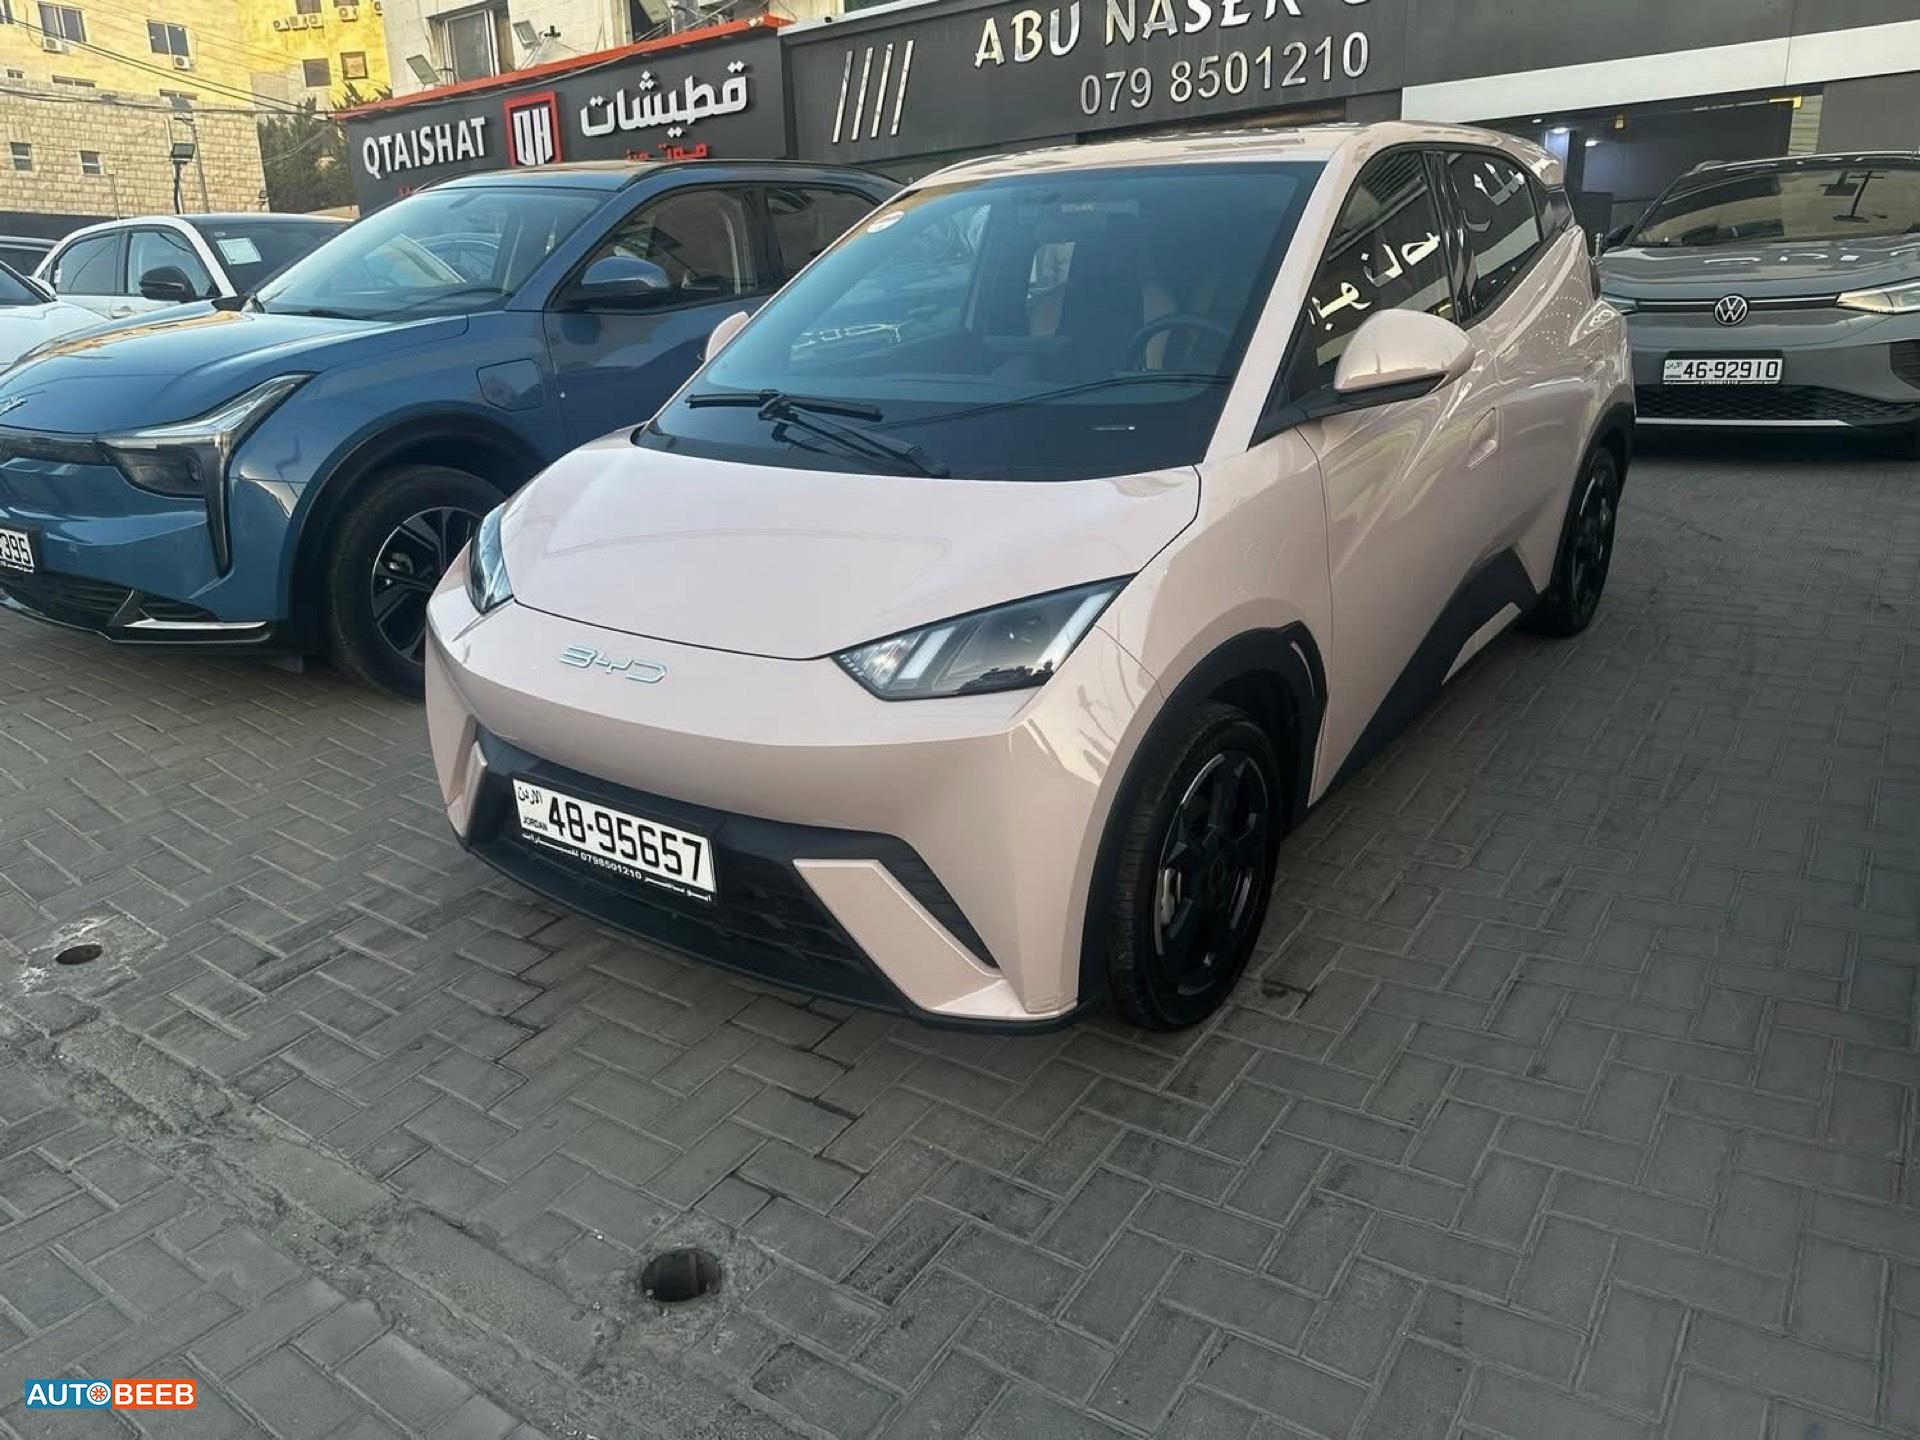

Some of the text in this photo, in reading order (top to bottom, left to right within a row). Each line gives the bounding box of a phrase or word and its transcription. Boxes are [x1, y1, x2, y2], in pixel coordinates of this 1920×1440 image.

[974, 3, 1081, 68] ABU
[580, 60, 747, 138] قطيشات
[1080, 31, 1370, 115] 079 8501210
[363, 116, 486, 179] QTAISHAT
[1683, 361, 1779, 379] 46-92910
[0, 533, 32, 564] 395
[560, 645, 668, 684] BYD
[522, 816, 548, 832] JORDAN
[550, 796, 702, 882] 48-95657
